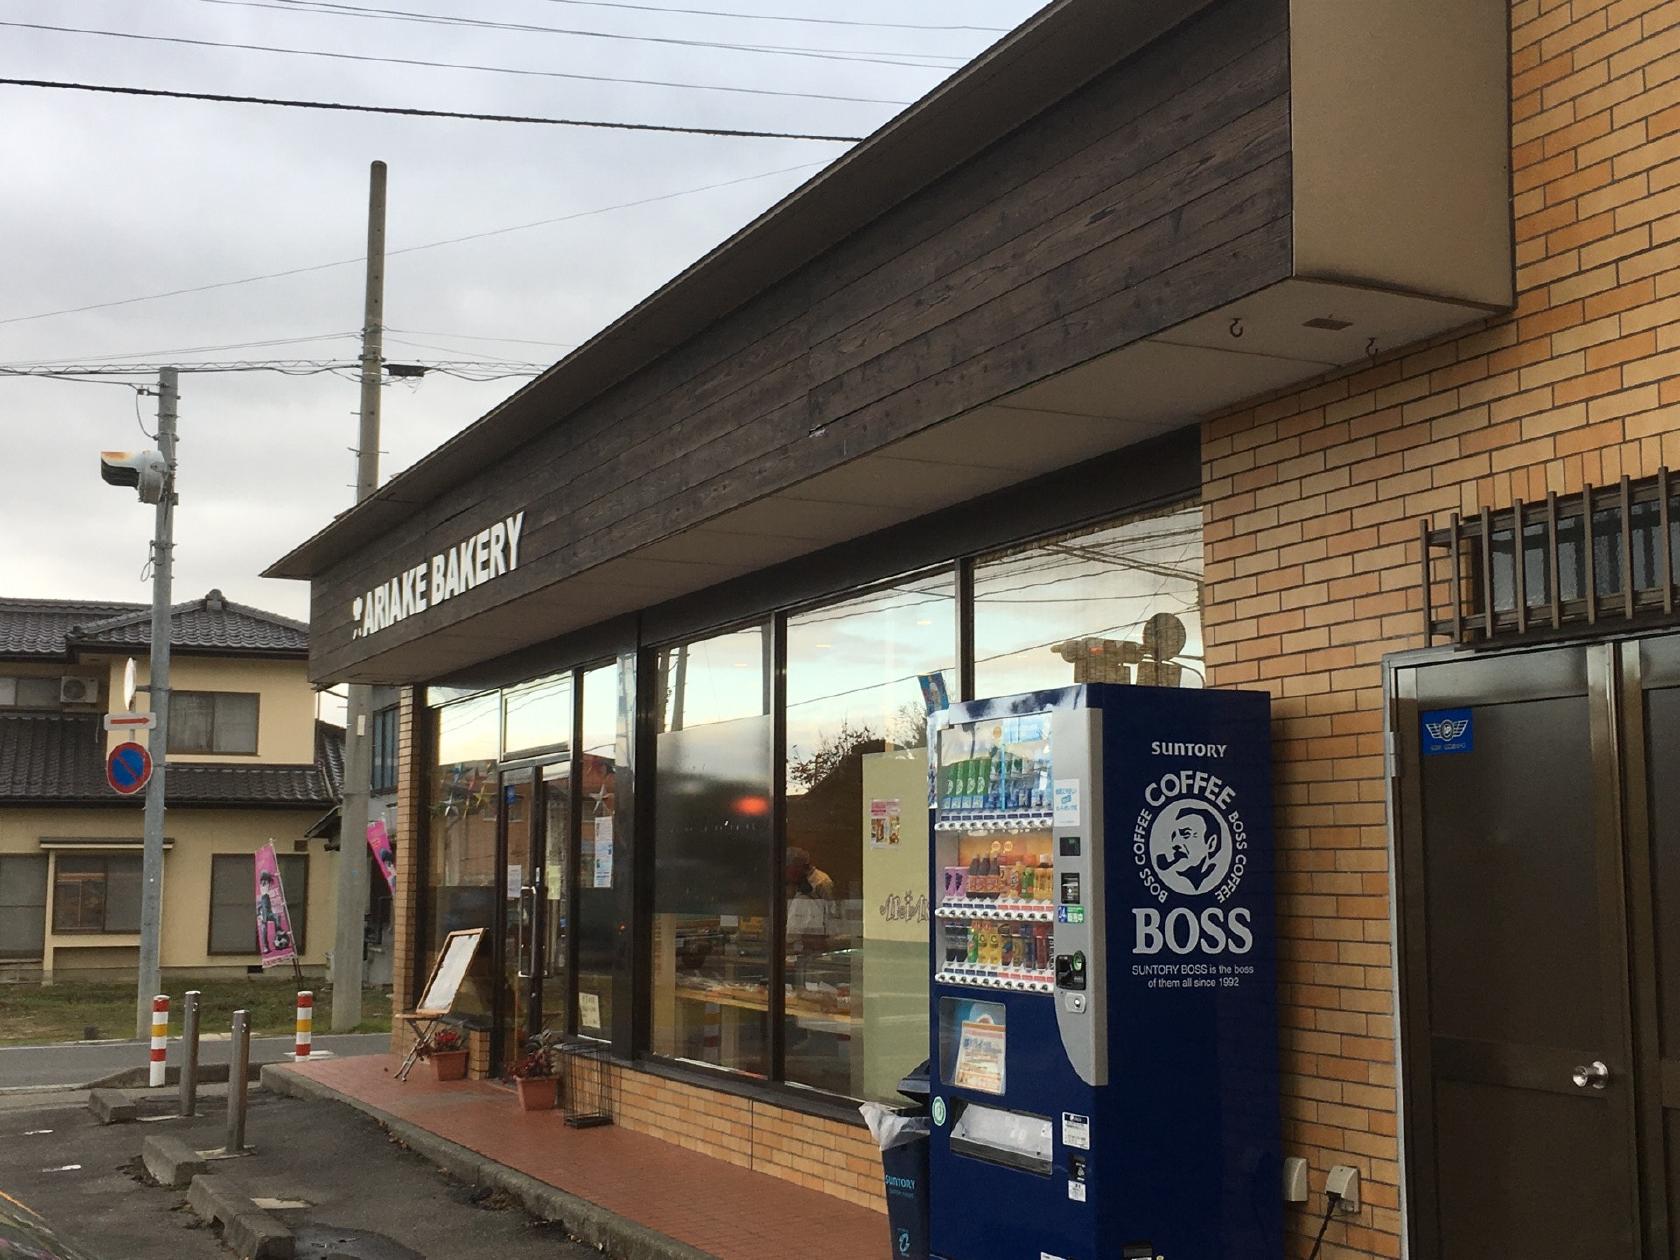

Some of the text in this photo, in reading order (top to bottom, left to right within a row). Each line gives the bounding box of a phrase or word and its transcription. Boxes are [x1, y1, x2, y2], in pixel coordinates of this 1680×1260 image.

[363, 511, 525, 637] ARIAKE BAKERY
[1151, 741, 1228, 758] SUNTORY
[1145, 770, 1236, 810] COFFEE
[1133, 808, 1168, 903] BOSS COFFEE
[1215, 810, 1247, 904] BOSS COFFEE
[1132, 907, 1253, 955] BOSS
[1132, 964, 1254, 975] SUNTORY BOSS is the boss
[1148, 977, 1240, 988] of them all since 1992
